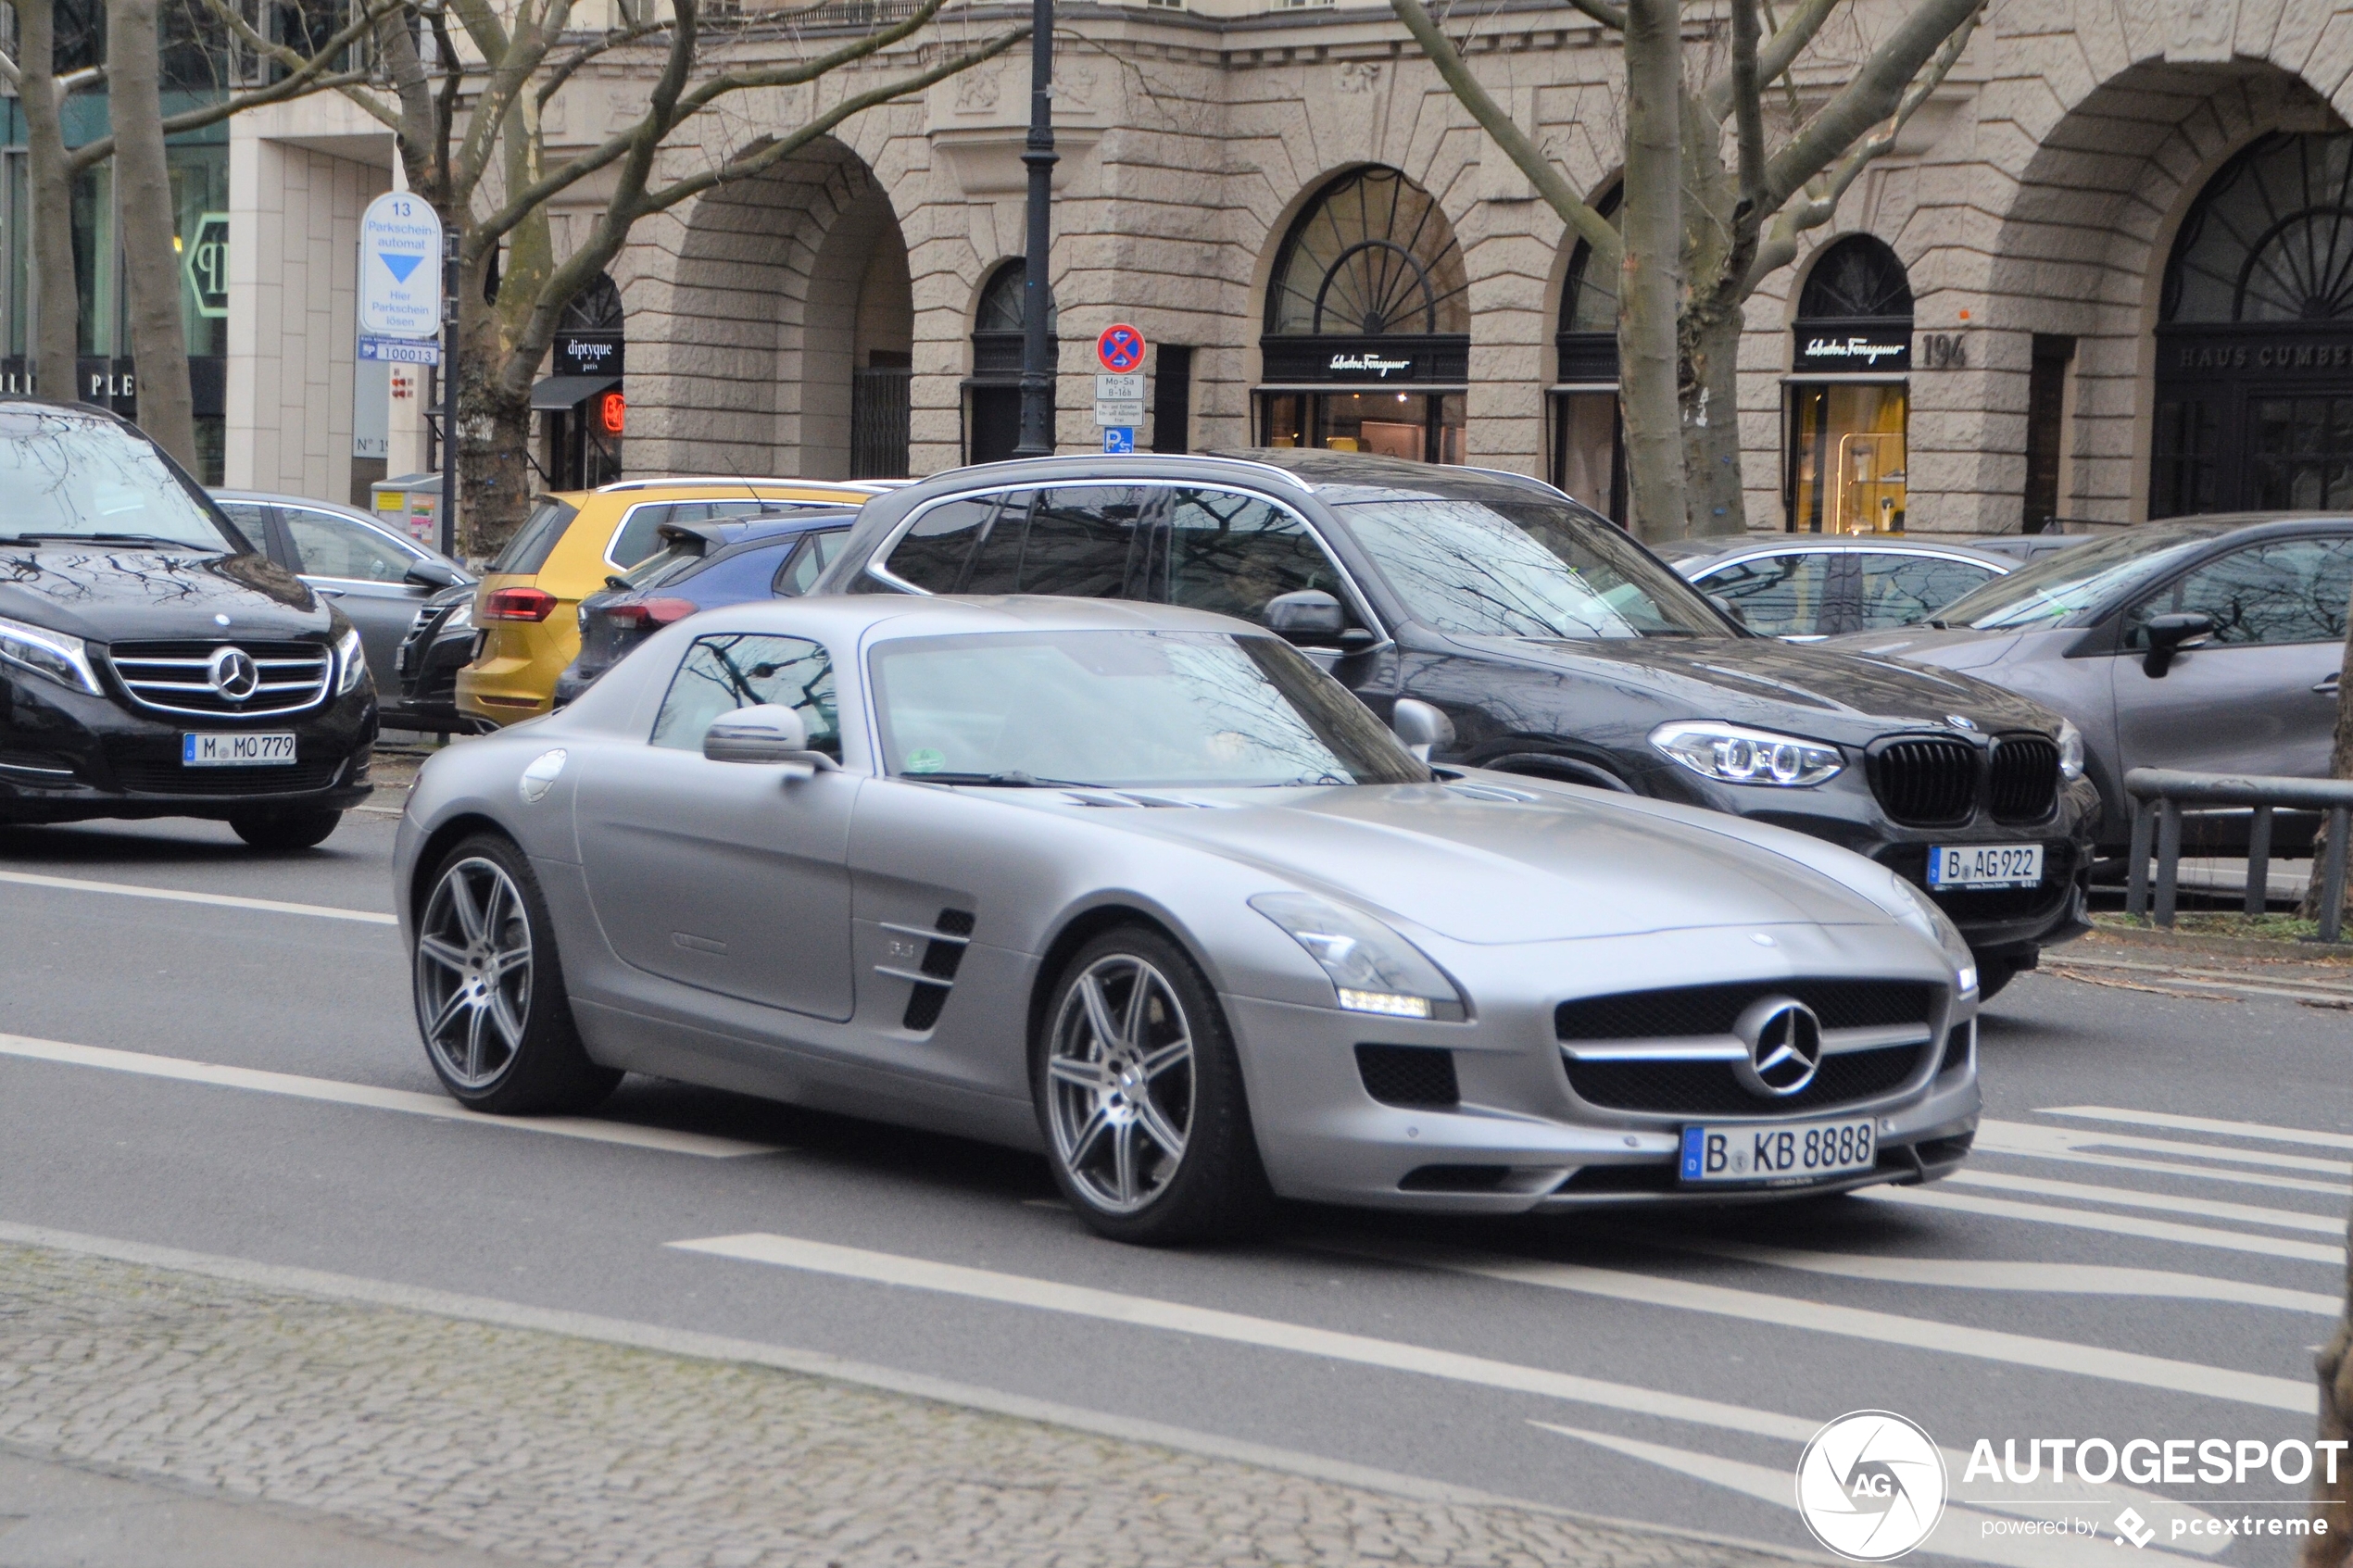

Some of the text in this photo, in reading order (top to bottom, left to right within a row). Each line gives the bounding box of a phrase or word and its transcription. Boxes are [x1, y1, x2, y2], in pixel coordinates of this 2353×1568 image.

[393, 202, 411, 217] 13
[368, 221, 436, 235] Parkschein-
[378, 237, 425, 249] automat
[390, 290, 410, 300] Hier
[372, 301, 429, 315] Parkschein
[386, 316, 414, 326] lösen
[385, 348, 432, 362] 100013
[568, 339, 612, 360] diptyque
[1847, 337, 1905, 365] Ferragamo
[1923, 333, 1966, 367] 194
[2180, 344, 2353, 368] HAUS CUMBE
[583, 362, 598, 371] paris
[1106, 377, 1134, 385] Mo-Sa
[380, 440, 388, 452] 1
[1106, 430, 1121, 452] P
[204, 736, 294, 758] M MO 779
[1948, 849, 2033, 878] B AG 922
[1706, 1123, 1871, 1173] B KB 8888
